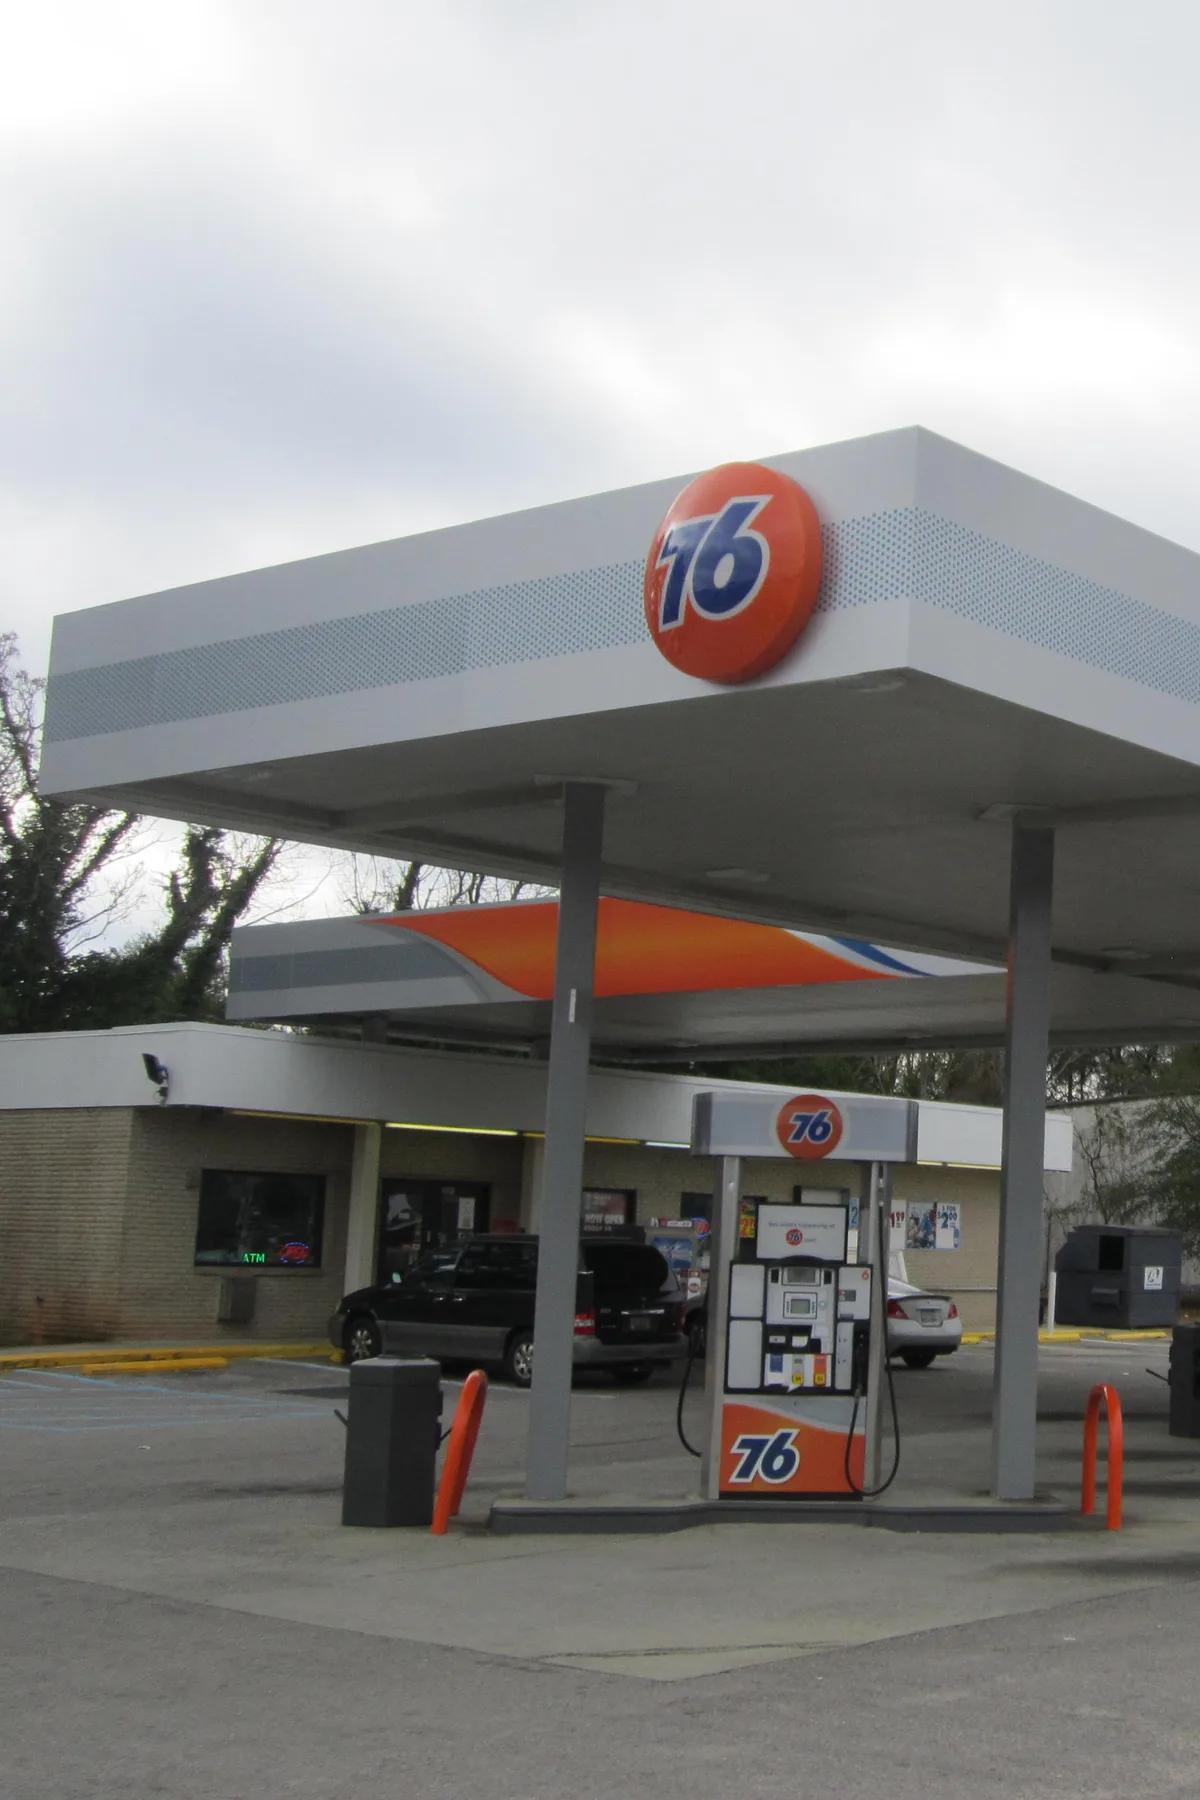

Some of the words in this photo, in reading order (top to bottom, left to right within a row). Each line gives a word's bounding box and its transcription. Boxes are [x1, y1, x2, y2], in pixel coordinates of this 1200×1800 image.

[655, 494, 774, 633] 76
[788, 1109, 834, 1144] 76
[243, 1253, 265, 1263] ATM
[729, 1427, 800, 1485] 76
